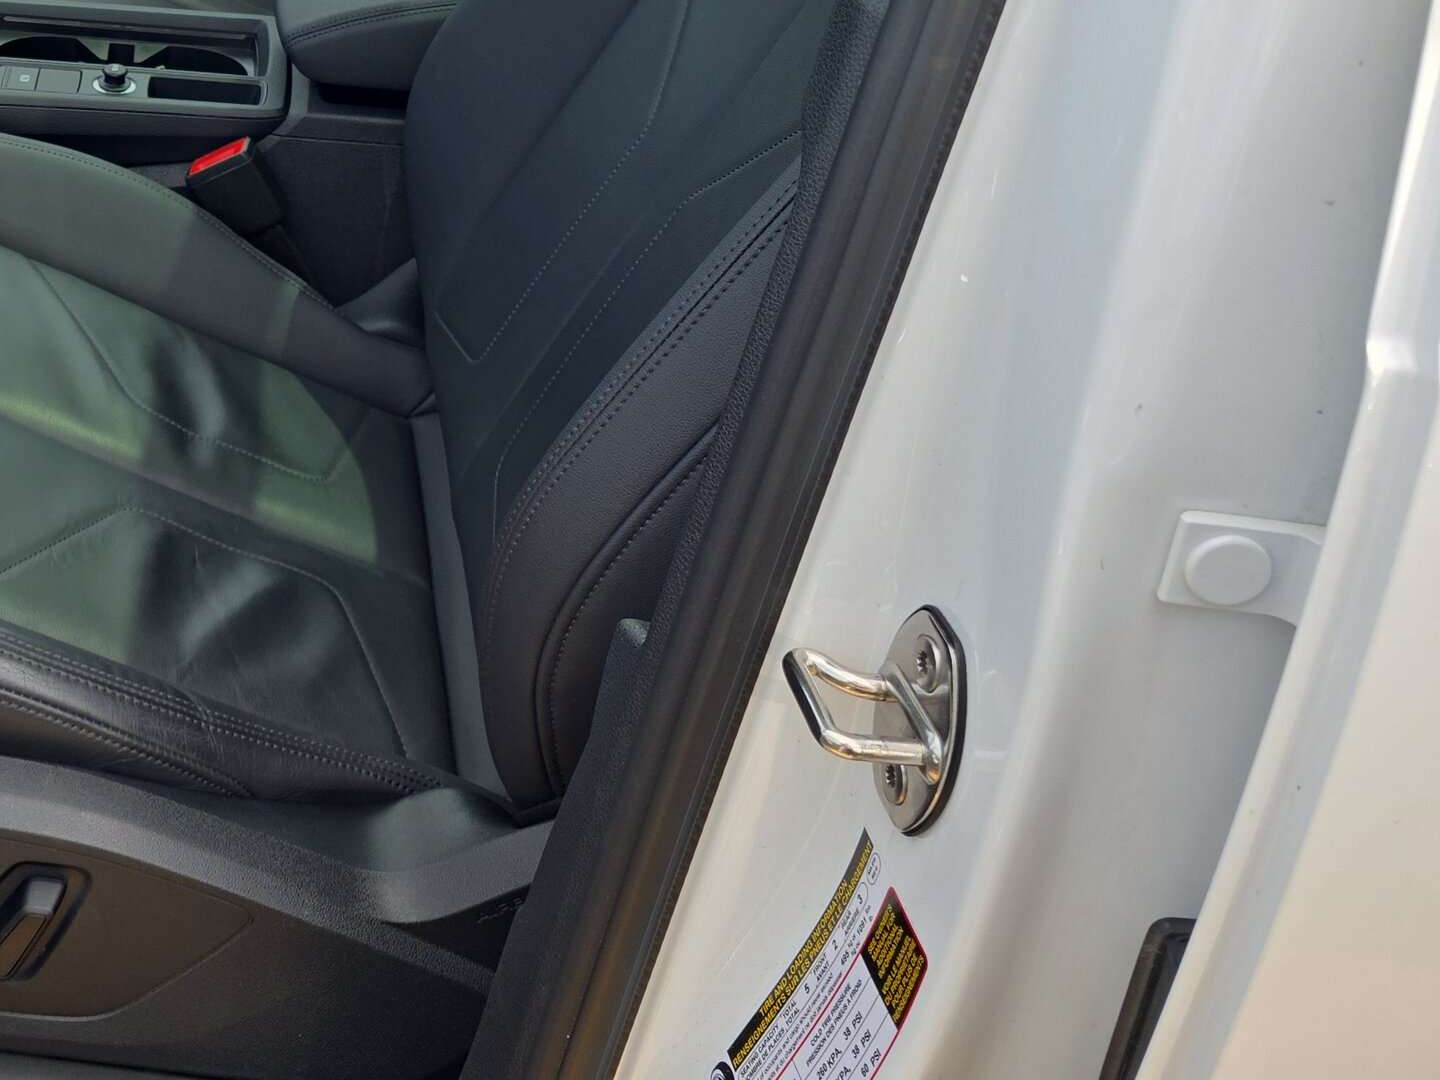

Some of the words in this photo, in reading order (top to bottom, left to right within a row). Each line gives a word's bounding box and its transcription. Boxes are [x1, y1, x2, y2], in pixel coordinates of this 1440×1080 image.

[732, 993, 787, 1069] RENSEIGNEMENTS
[797, 957, 811, 977] LES
[809, 929, 830, 961] PNEUS
[841, 839, 872, 906] CHARGEMENT
[759, 995, 775, 1016] TIRE
[773, 977, 788, 998] AND
[786, 940, 813, 980] LOADING
[811, 879, 848, 942] INFORMATION
[740, 1051, 759, 1076] SEATING
[758, 1024, 779, 1053] CAPACITY
[782, 1001, 797, 1020] TOTAL
[803, 983, 810, 994] 5
[832, 939, 839, 951] 2
[857, 893, 863, 905] 3
[785, 1008, 800, 1027] TOTAL
[842, 1026, 851, 1041] 38
[851, 1011, 863, 1030] PSI
[810, 1029, 822, 1047] COLD
[851, 1044, 860, 1059] 38
[860, 1029, 872, 1048] PSI
[860, 1063, 869, 1078] 60
[869, 1047, 882, 1068] PSI
